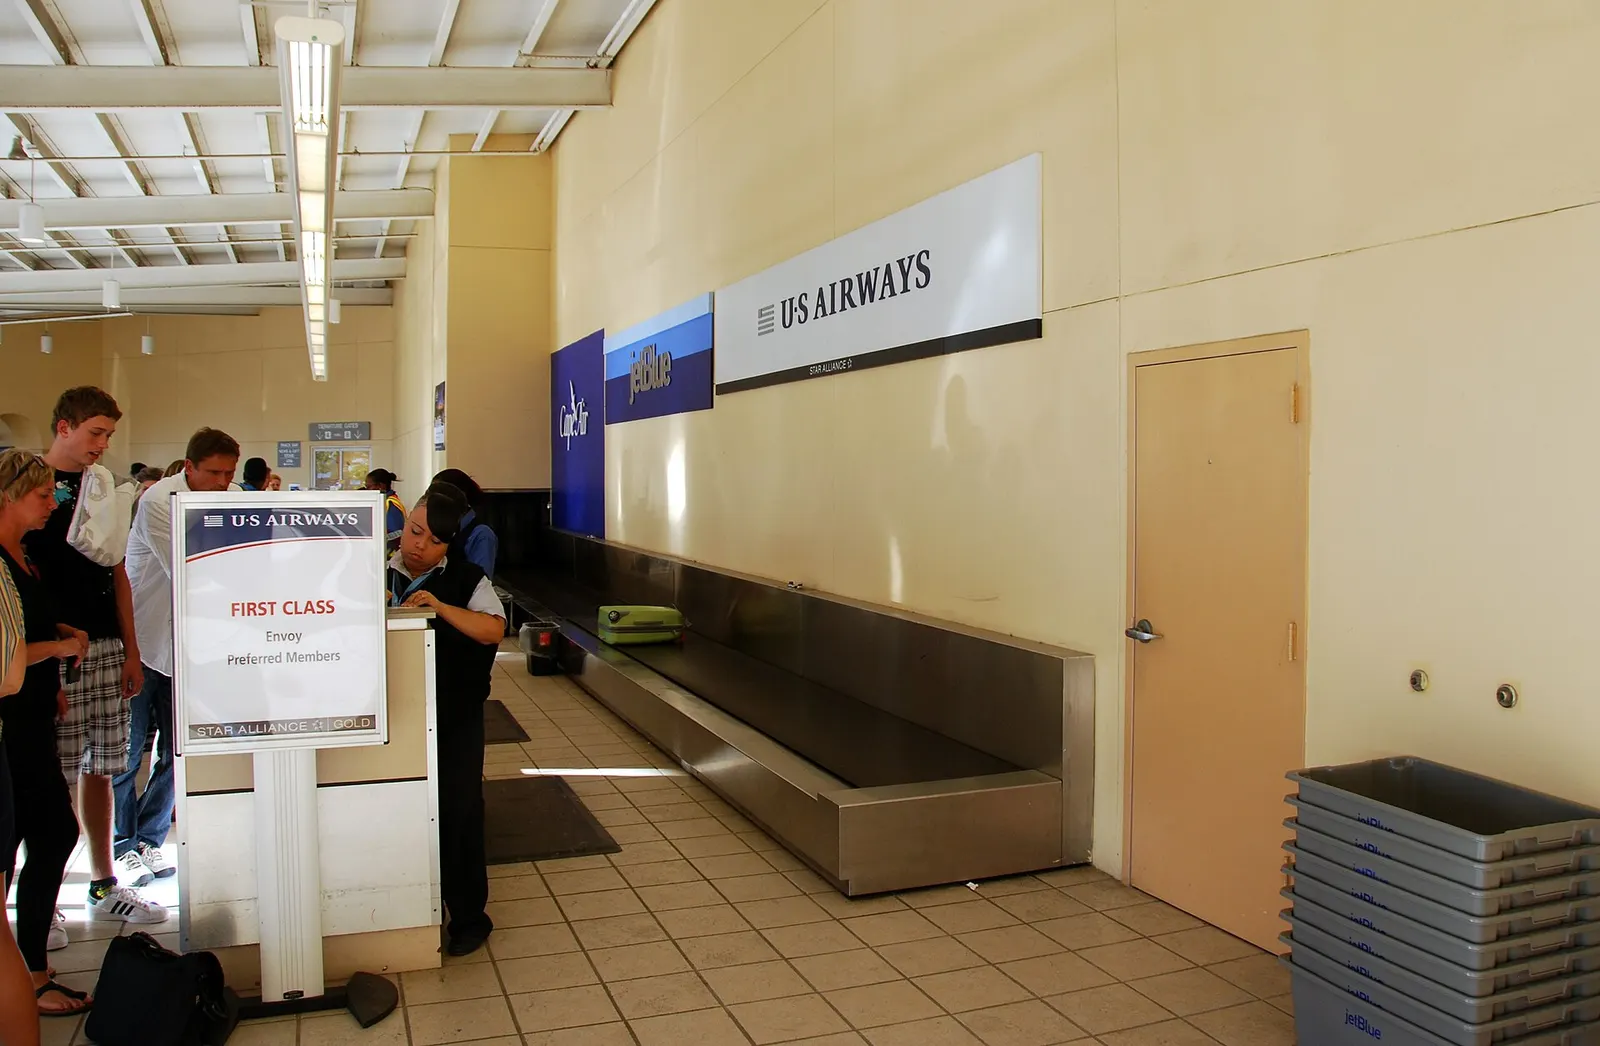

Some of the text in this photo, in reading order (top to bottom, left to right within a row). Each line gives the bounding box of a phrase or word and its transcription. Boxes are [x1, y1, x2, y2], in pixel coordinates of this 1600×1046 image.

[813, 249, 931, 320] AIRWAYS
[629, 343, 671, 405] jetBlue
[809, 359, 847, 375] STAR ALLIANCE
[265, 513, 358, 527] AIRWAYS
[231, 600, 335, 616] FIRST CLASS
[266, 631, 302, 644] Envoy
[227, 650, 341, 665] Preferred Members
[197, 720, 308, 737] STAR ALLIANCE
[333, 717, 371, 729] GOLD
[1345, 1008, 1381, 1040] jetBlue
